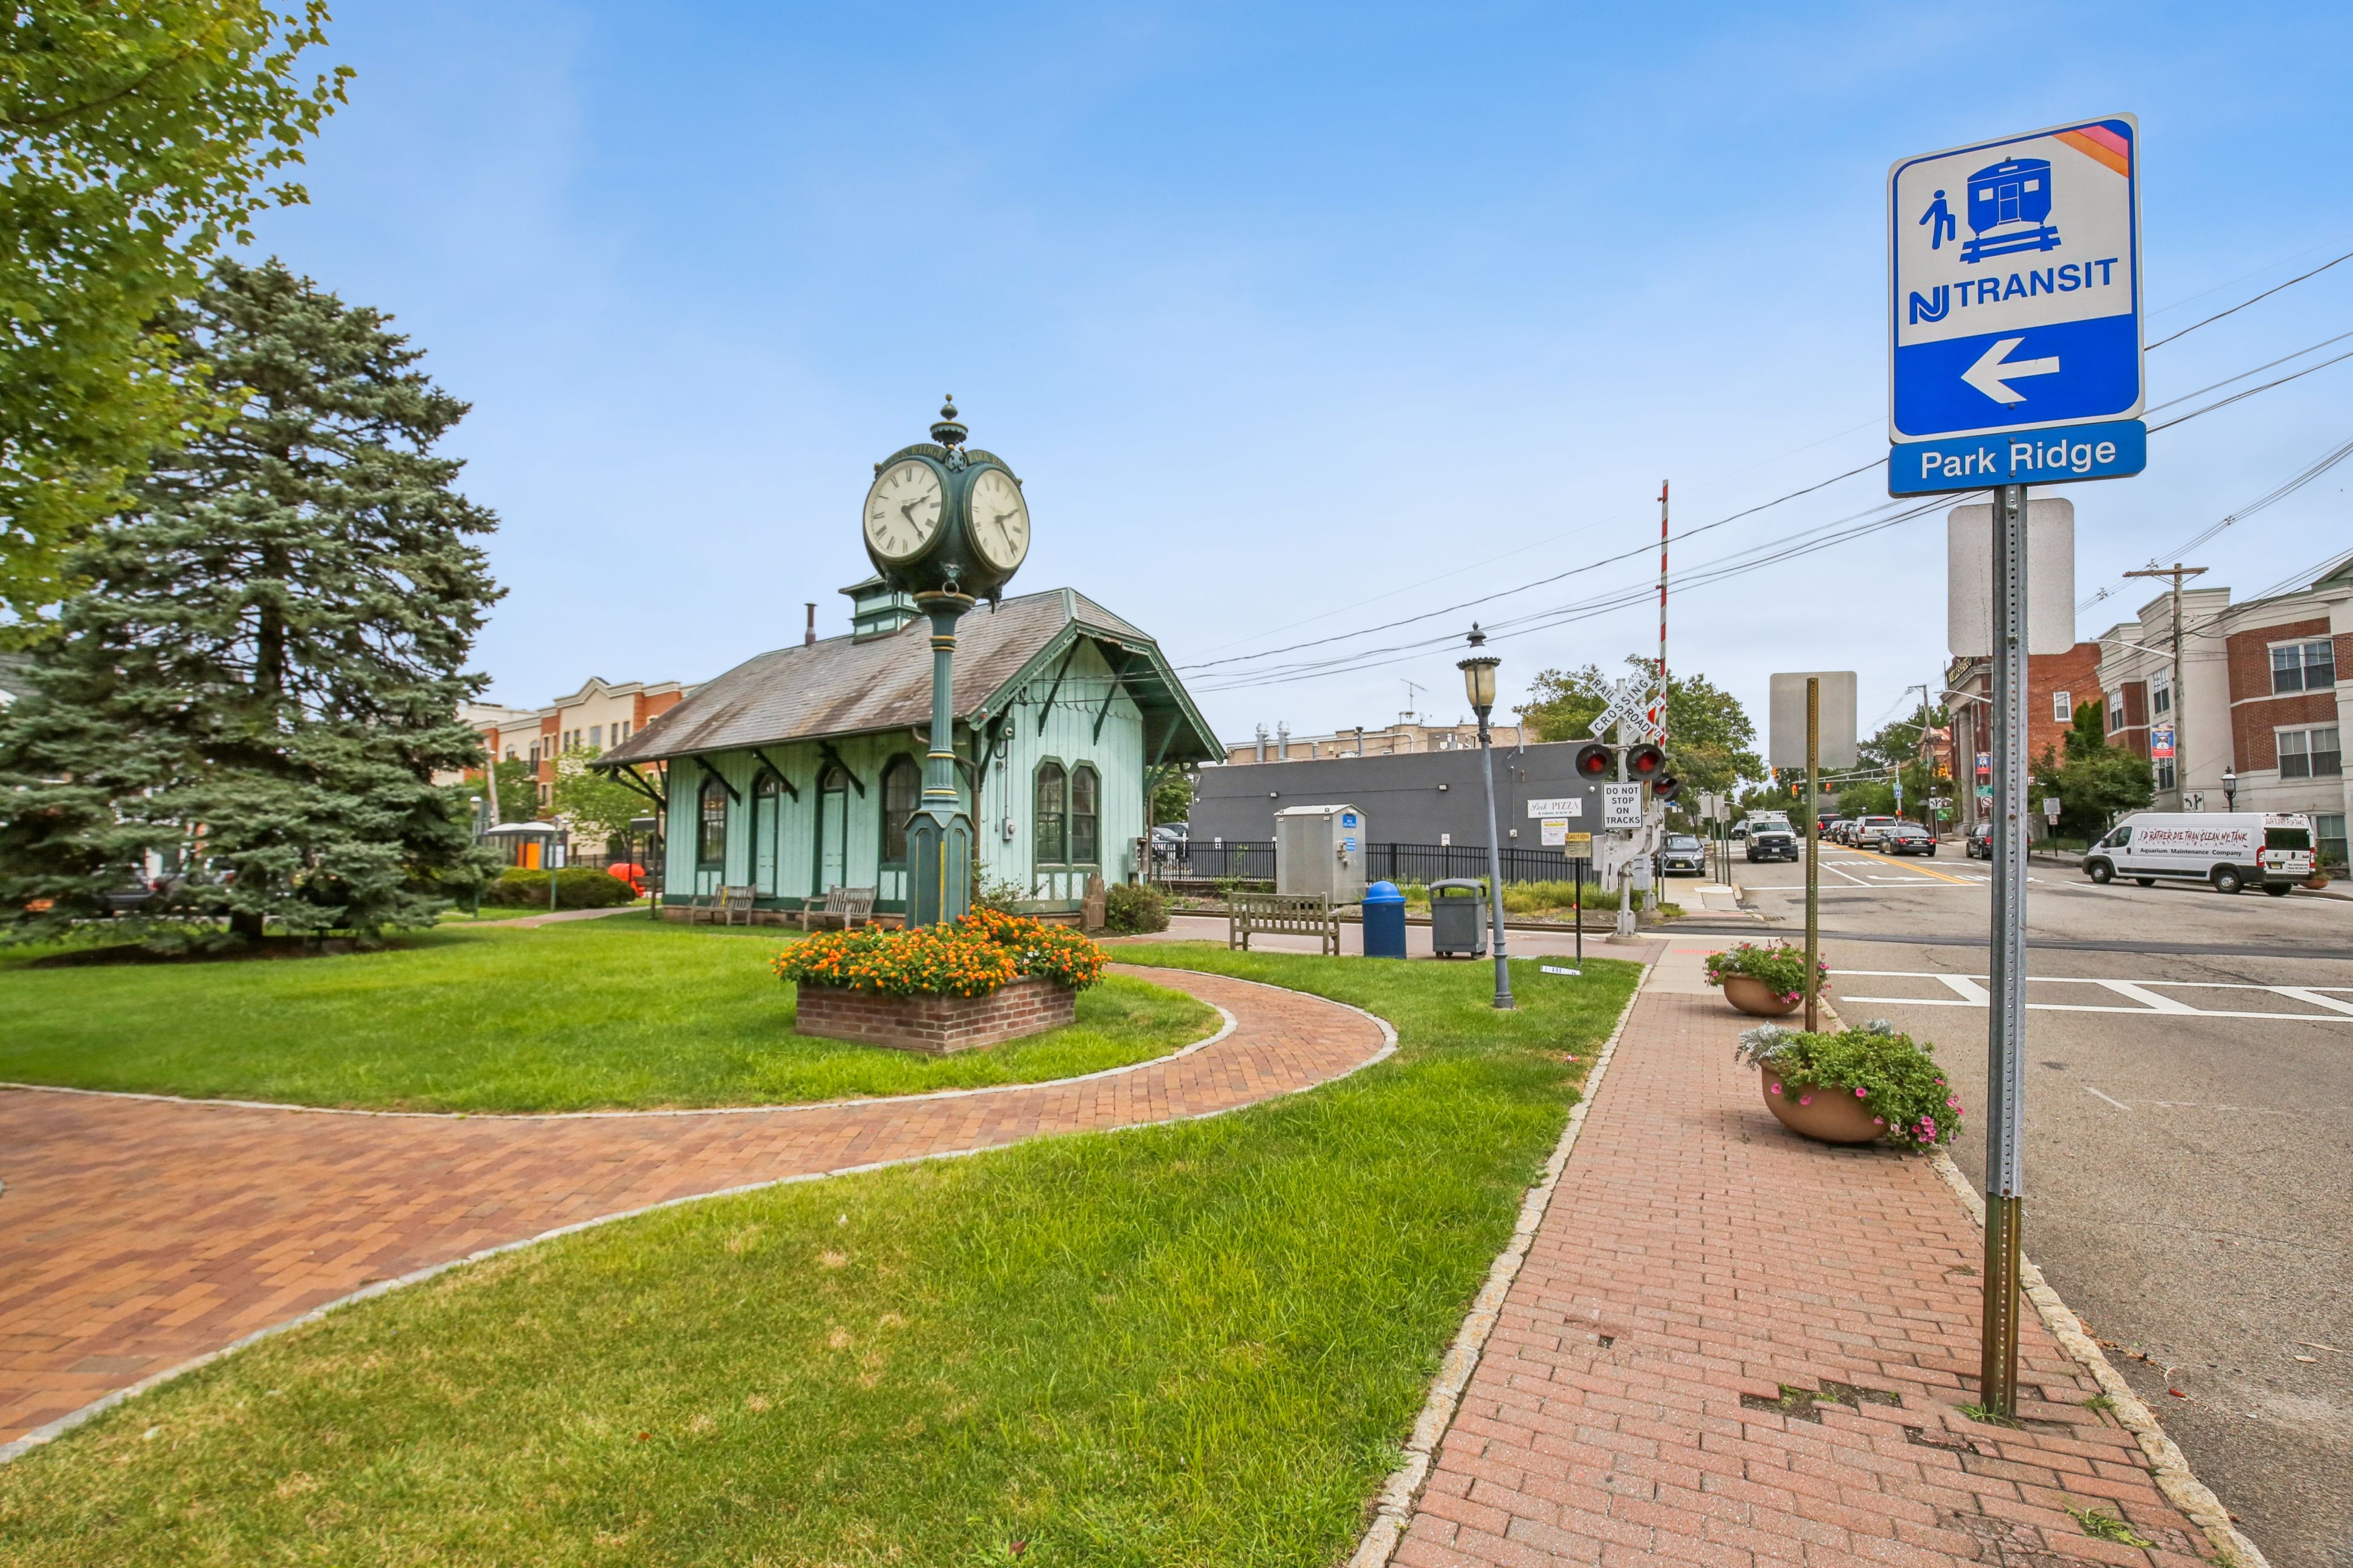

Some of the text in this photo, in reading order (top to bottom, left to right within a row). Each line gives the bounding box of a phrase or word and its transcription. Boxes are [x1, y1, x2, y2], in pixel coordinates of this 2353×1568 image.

[911, 445, 944, 458] RIDGE
[1921, 439, 2117, 479] Park Ridge
[1592, 679, 1614, 702] RAIL
[1624, 708, 1650, 732] ROAD
[1594, 679, 1648, 731] CROSSING
[1530, 801, 1579, 811] Park PIZZA
[2149, 830, 2172, 841] RATHER
[2173, 831, 2184, 840] DIE
[2185, 831, 2199, 841] THAN
[2200, 831, 2219, 842] CLEAN
[2221, 831, 2230, 843] MY
[2231, 831, 2247, 842] TANK
